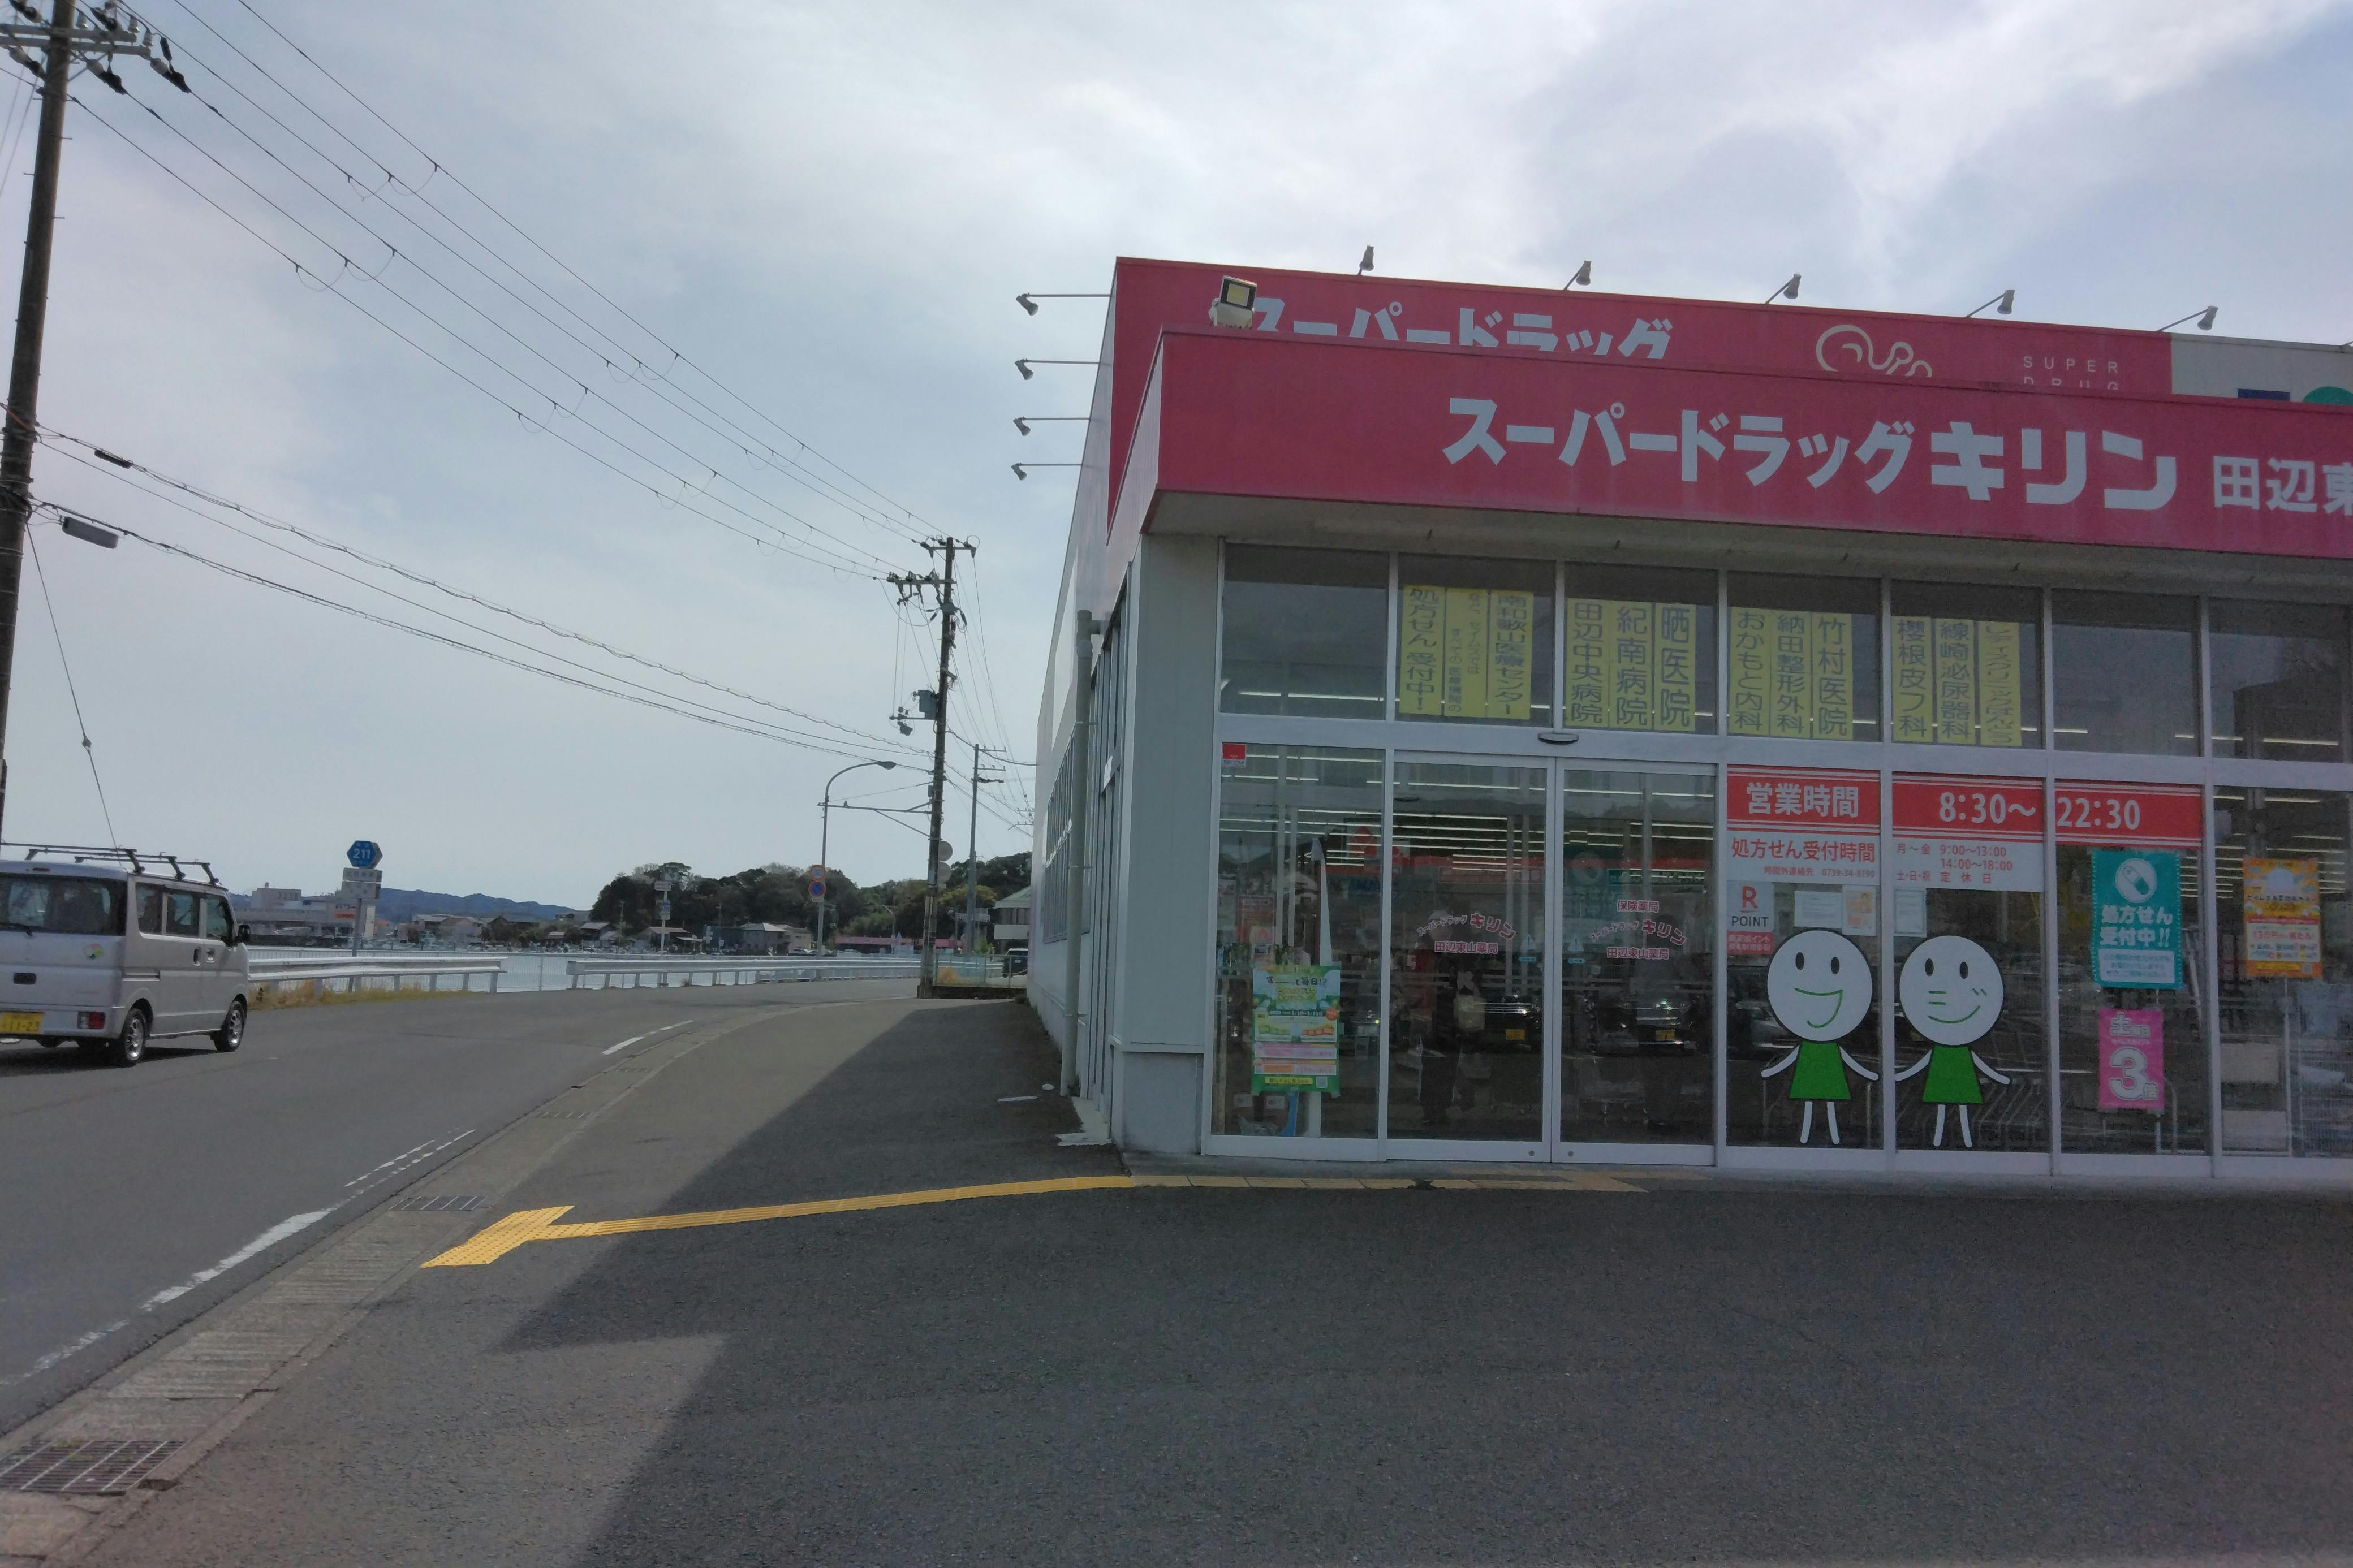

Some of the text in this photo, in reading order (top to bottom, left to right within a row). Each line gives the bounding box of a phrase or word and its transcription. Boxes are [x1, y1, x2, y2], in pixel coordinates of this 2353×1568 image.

[2023, 356, 2118, 374] SUPER
[2213, 456, 2353, 516] 田辺東
[1406, 588, 1440, 710] 処方せん受付中!
[1494, 595, 1527, 714] 南和歌山医療センター
[1570, 603, 1604, 724] 田辺中央病院
[1615, 605, 1648, 726] 紀南病院
[1660, 607, 1691, 727] 晒医院
[1734, 611, 1765, 731] おかもと内科
[1776, 614, 1806, 734] 納田整形外科
[1817, 617, 1847, 737] 竹村医院
[1746, 782, 1859, 818] 営業時間
[2057, 797, 2141, 830] 22:30
[352, 848, 371, 859] 211
[1731, 837, 1876, 863] 処方せん受付時間
[1764, 866, 1814, 876] 時間外連絡先
[1617, 900, 1660, 913] 保険薬局
[1741, 885, 1759, 910] R
[1731, 915, 1769, 928] POINT
[2101, 905, 2173, 925] 処方せん
[1434, 941, 1498, 954] 田辺東山薬局
[2100, 926, 2171, 948] 受付中!!
[1606, 947, 1669, 960] 田辺東山薬局
